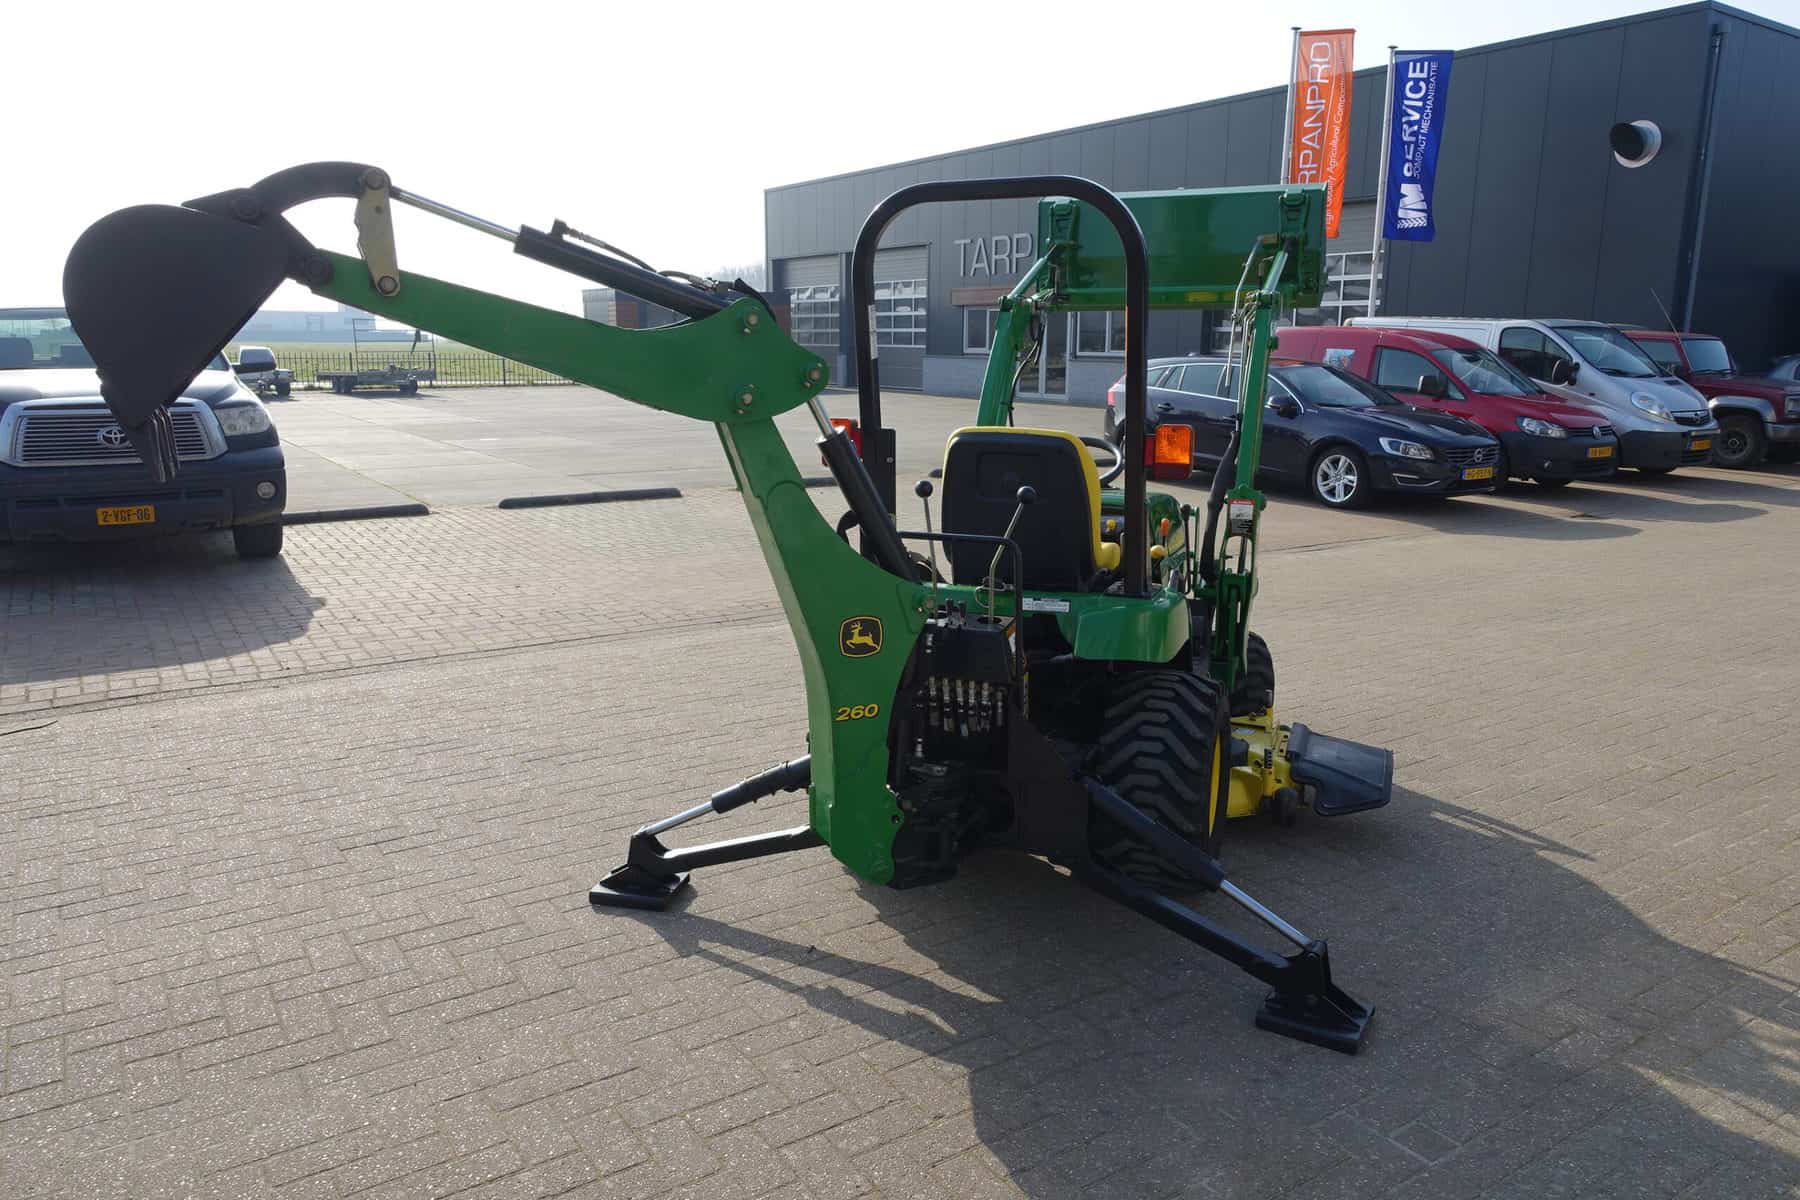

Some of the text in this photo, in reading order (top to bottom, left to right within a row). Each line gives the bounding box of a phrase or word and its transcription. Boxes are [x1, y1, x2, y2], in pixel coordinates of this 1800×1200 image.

[1402, 60, 1430, 178] SERVICE
[1420, 60, 1439, 134] MECHANISATIE
[835, 703, 880, 721] 260
